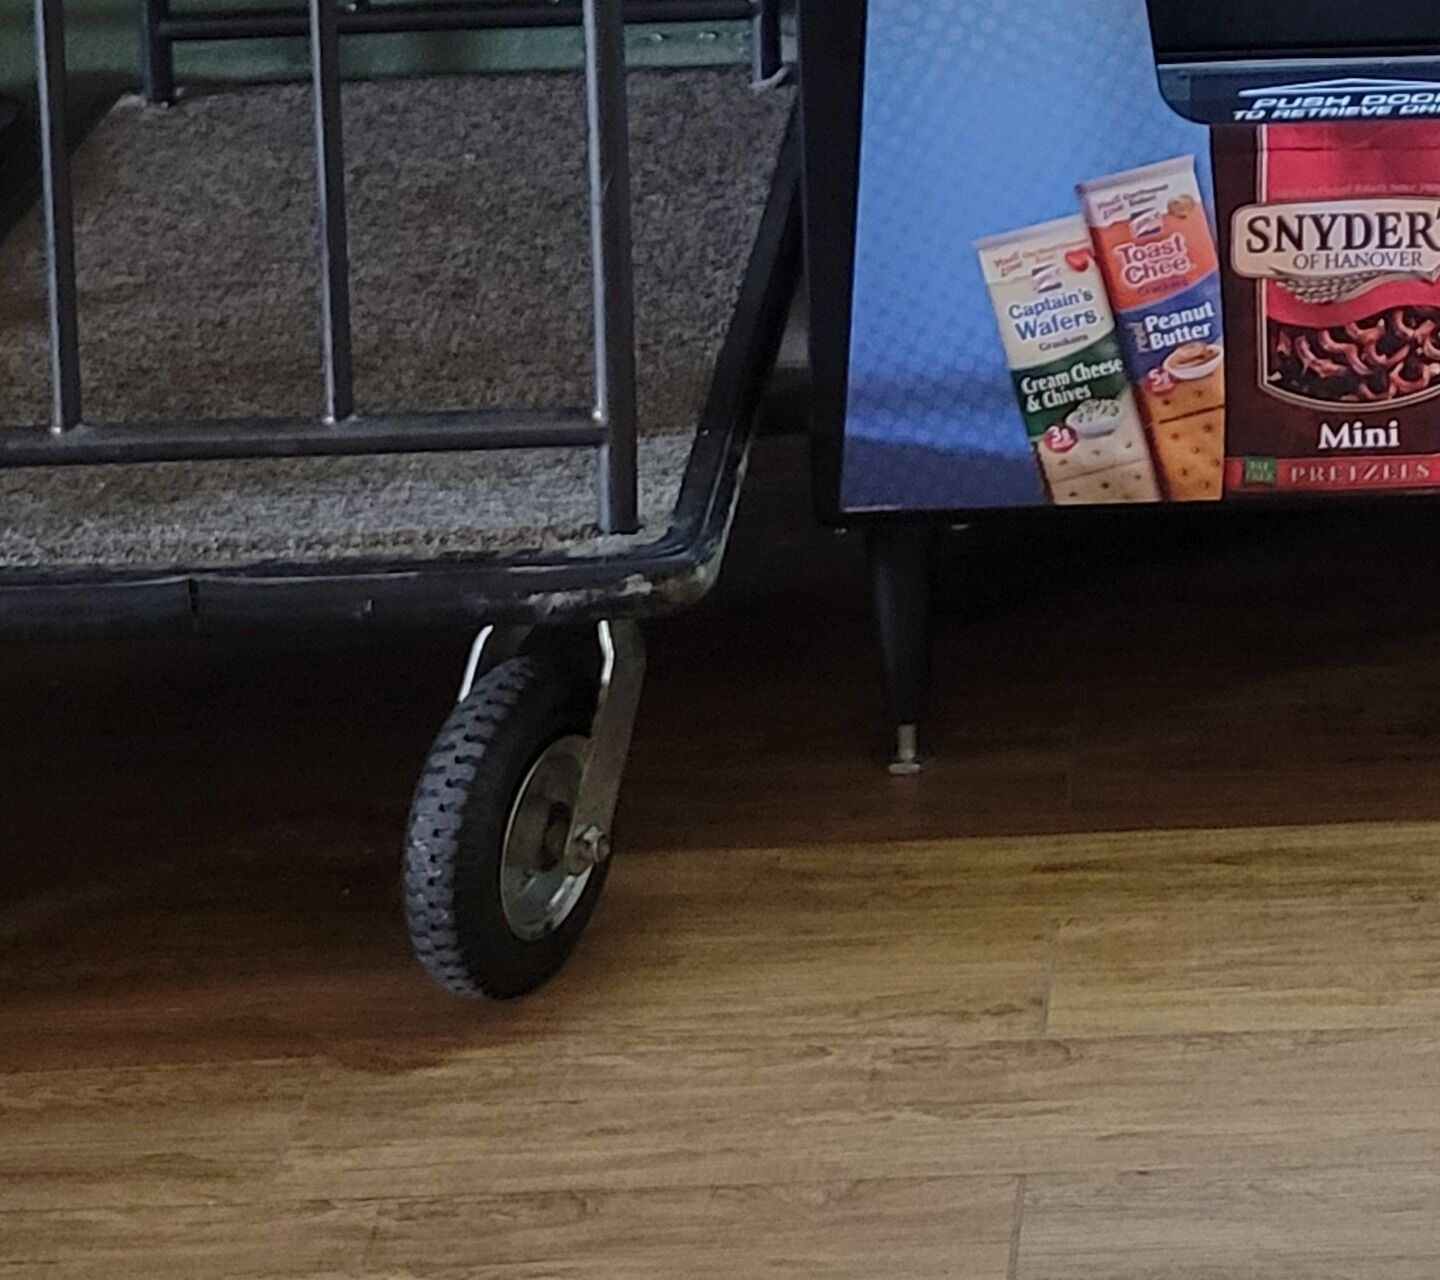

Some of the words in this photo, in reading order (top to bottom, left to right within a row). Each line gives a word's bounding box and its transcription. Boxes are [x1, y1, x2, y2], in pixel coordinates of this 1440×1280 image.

[1233, 109, 1266, 121] TO
[1271, 105, 1394, 119] RETRIEVE
[1253, 95, 1358, 110] PUSH
[1117, 235, 1184, 265] Toast
[1292, 251, 1321, 271] OF
[1324, 249, 1425, 270] HANOVER
[1124, 257, 1188, 285] Chee
[1008, 288, 1094, 320] Captain's
[1144, 301, 1215, 332] Peanut
[1014, 309, 1098, 341] Wafers
[1149, 323, 1212, 350] Butter
[1021, 370, 1070, 396] Cream
[1071, 356, 1124, 384] Cheese
[1026, 397, 1043, 413] &
[1043, 383, 1092, 409] Chives
[1317, 419, 1400, 450] Mini
[1290, 463, 1431, 483] PRETZELS
